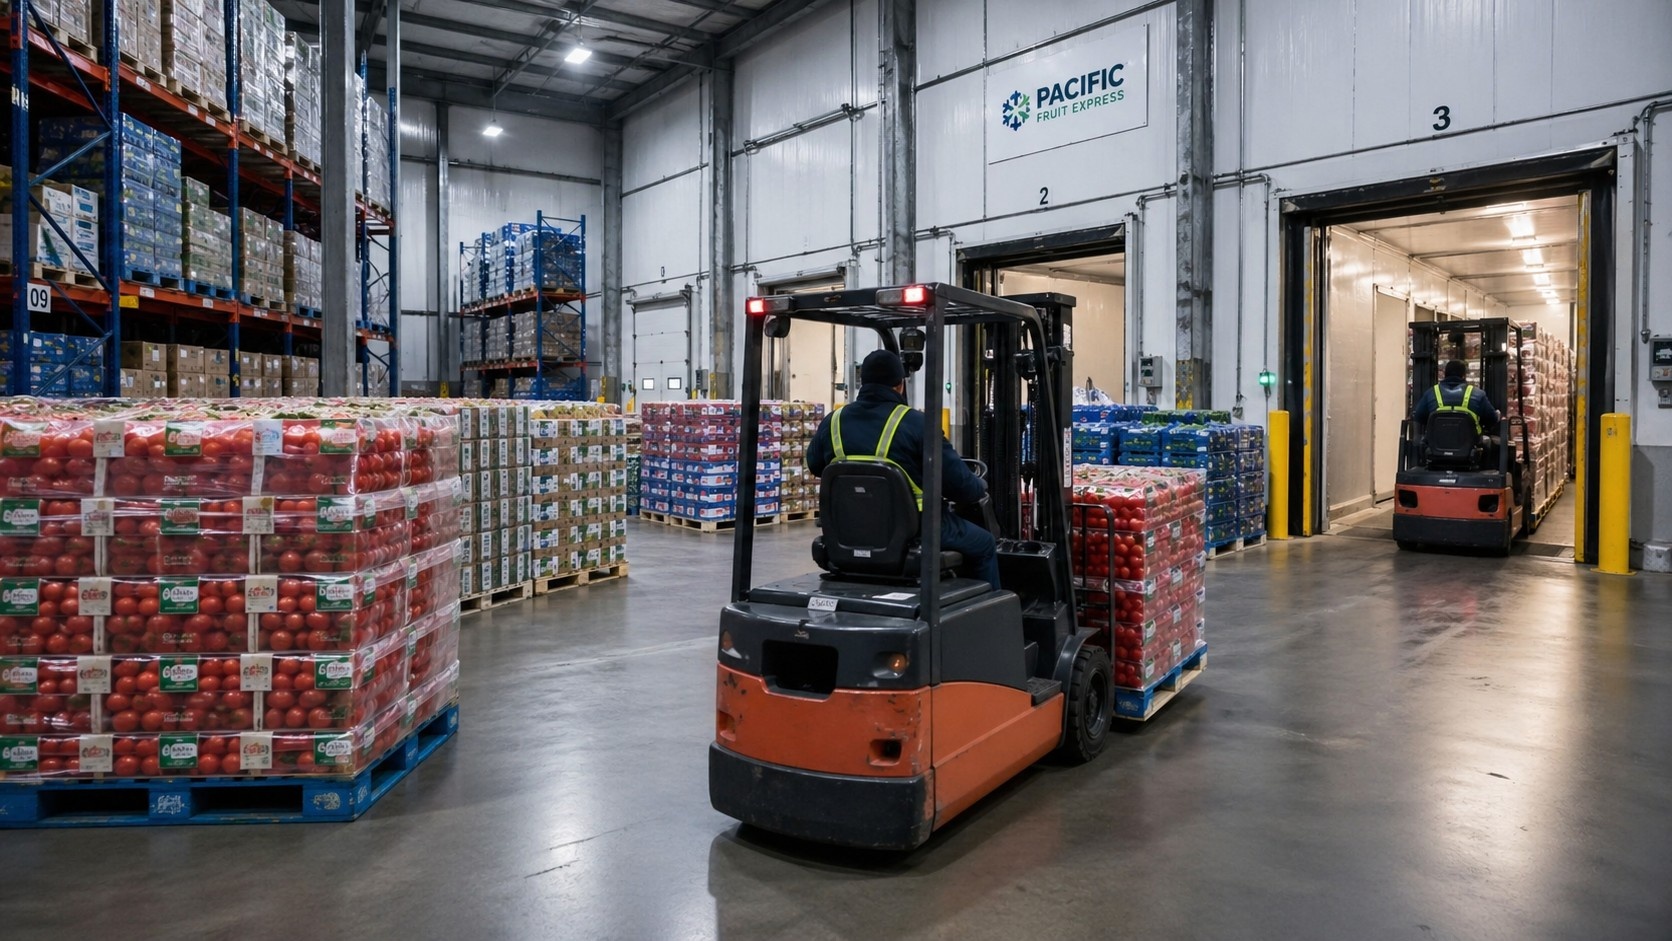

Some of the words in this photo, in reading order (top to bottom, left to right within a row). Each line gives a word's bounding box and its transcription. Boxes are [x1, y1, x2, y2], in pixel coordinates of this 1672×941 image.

[1036, 63, 1125, 109] PACIFIC
[1036, 105, 1068, 123] FRUIT
[1072, 89, 1125, 114] EXPRESS
[1432, 105, 1451, 131] 3
[1039, 186, 1049, 206] 2
[30, 287, 48, 309] 09
